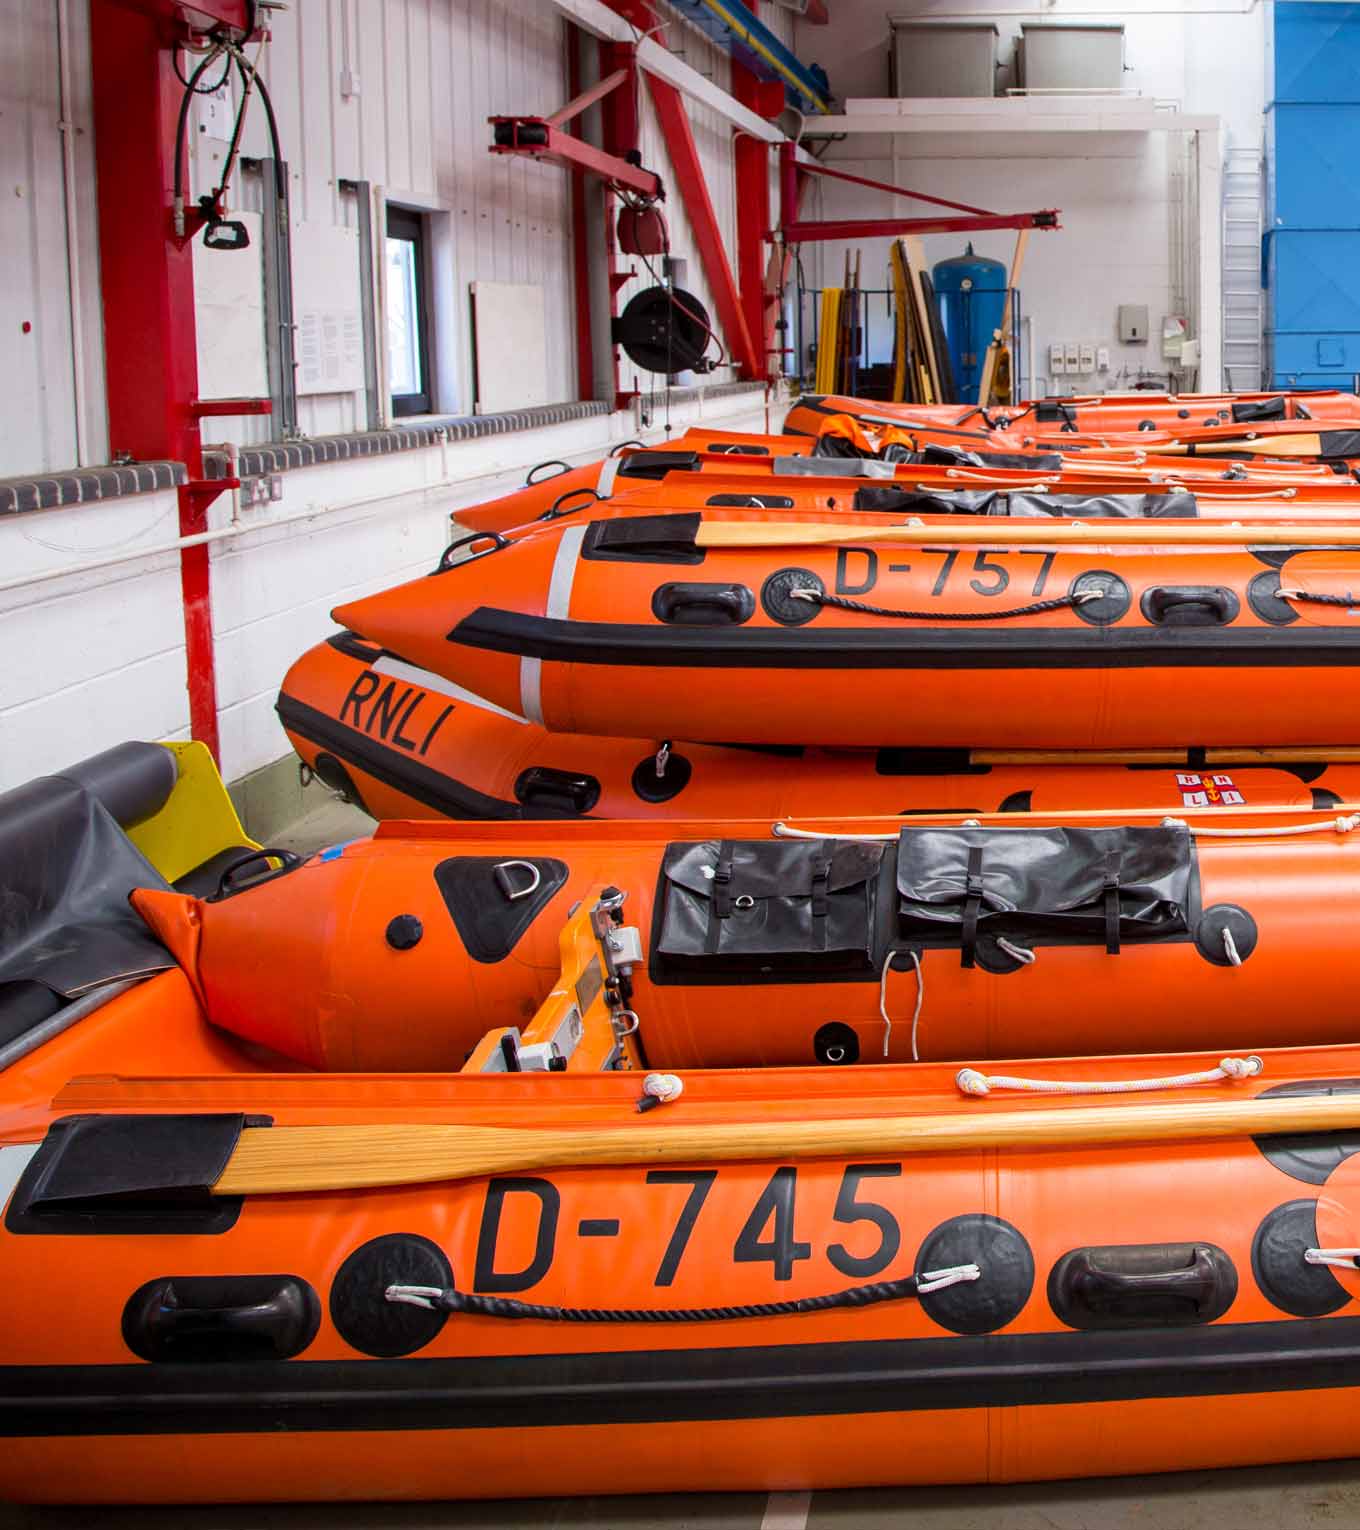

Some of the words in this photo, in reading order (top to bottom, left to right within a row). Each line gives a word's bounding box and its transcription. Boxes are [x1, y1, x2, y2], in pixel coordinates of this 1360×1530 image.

[834, 546, 1058, 597] D-757
[339, 669, 456, 756] RNLI
[472, 1163, 902, 1294] D-745
